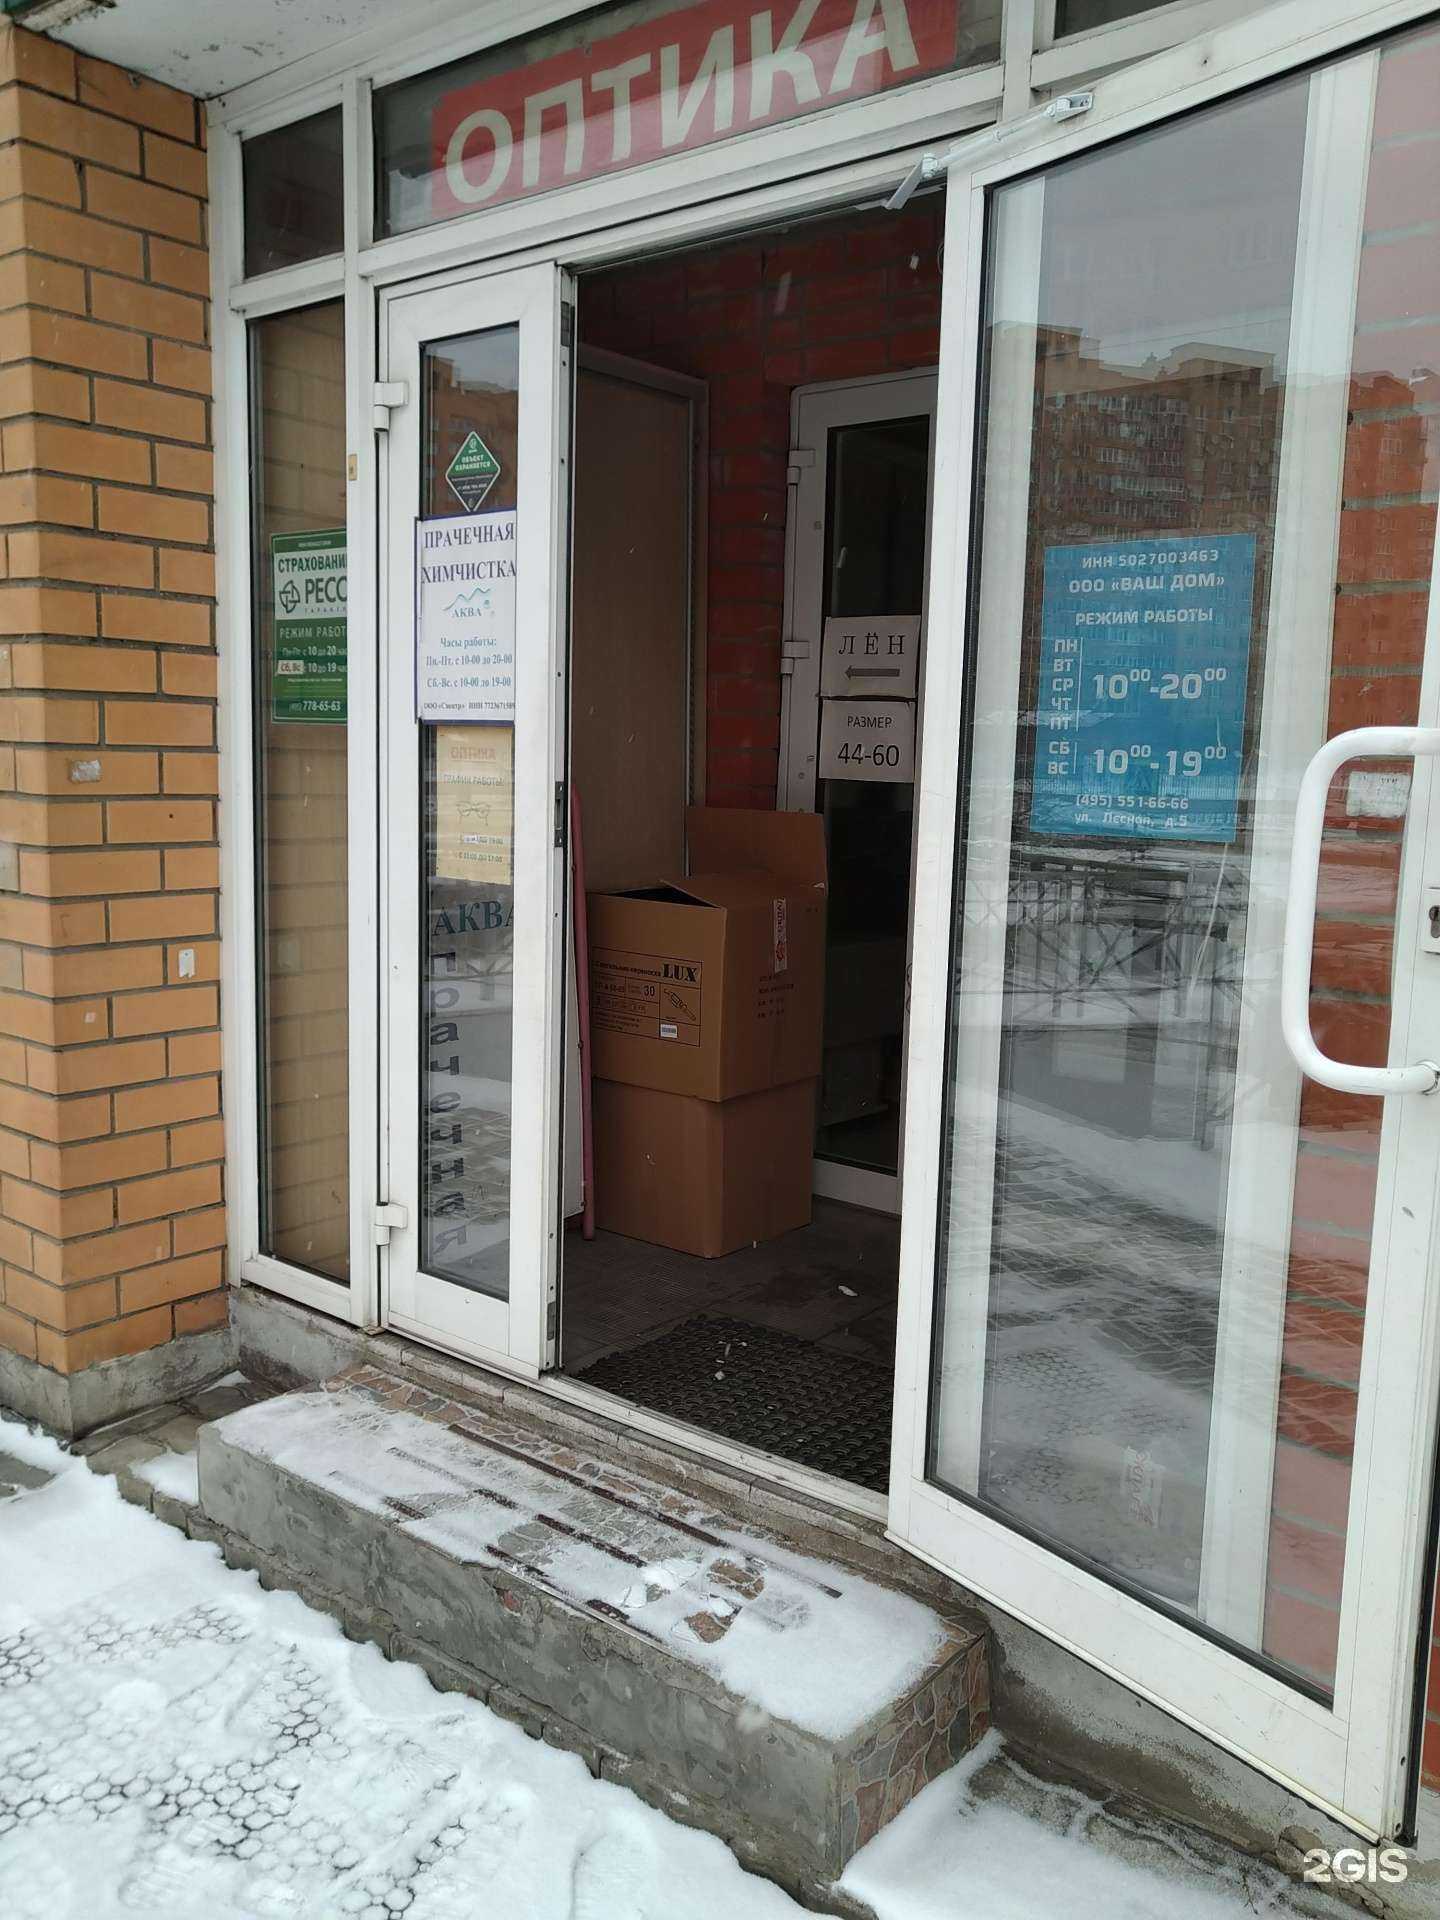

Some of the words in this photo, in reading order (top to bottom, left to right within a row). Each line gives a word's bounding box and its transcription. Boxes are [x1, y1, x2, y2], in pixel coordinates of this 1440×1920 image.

[445, 0, 919, 204] ОПТИКА
[424, 523, 514, 548] ПРАЧЕЧНАЯ
[1082, 556, 1112, 568] ИНН
[1119, 550, 1219, 566] 5027003463
[421, 560, 516, 584] ХИМЧИСТКА
[1069, 579, 1105, 593] ООО
[1112, 575, 1164, 592] «ВАШ
[1170, 573, 1225, 591] ДОМ»
[452, 607, 482, 618] АКВА
[1076, 611, 1138, 626] РЕЖИМ
[1144, 608, 1213, 623] РАБОТЫ
[279, 627, 313, 640] РЕЖИМ
[440, 637, 462, 648] Часы
[464, 636, 497, 650] работы:
[1054, 639, 1078, 653] ПН
[1053, 659, 1074, 672] ВТ
[1052, 679, 1074, 692] СР
[1051, 697, 1072, 711] ЧТ
[847, 716, 892, 729] РАЗМЕР
[1050, 717, 1071, 730] ПТ
[837, 742, 900, 767] 44-60
[1048, 741, 1070, 755] СБ
[1047, 761, 1069, 775] ВС
[1076, 794, 1112, 808] (495)
[1074, 813, 1092, 825] ул.
[662, 963, 698, 983] LUX
[643, 985, 656, 997] 30
